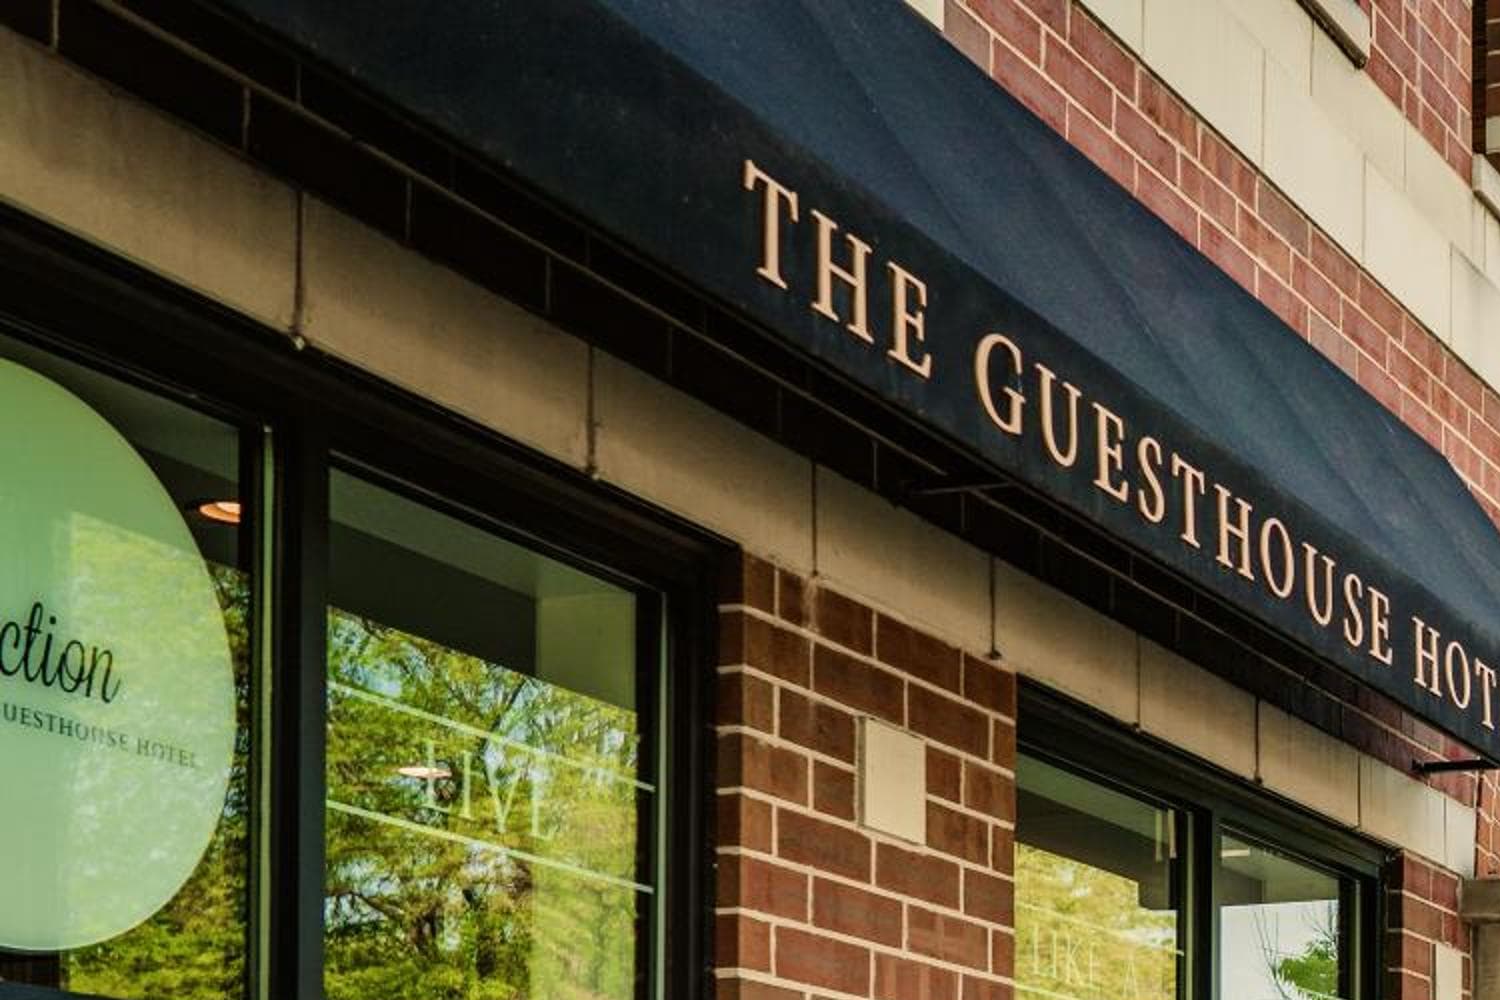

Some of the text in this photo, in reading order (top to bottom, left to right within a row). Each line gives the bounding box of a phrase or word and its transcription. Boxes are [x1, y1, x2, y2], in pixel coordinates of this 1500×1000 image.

[742, 159, 933, 380] THE
[973, 333, 1394, 667] GUESTHOUSE
[0, 602, 121, 704] ction
[136, 738, 198, 768] HOTEL
